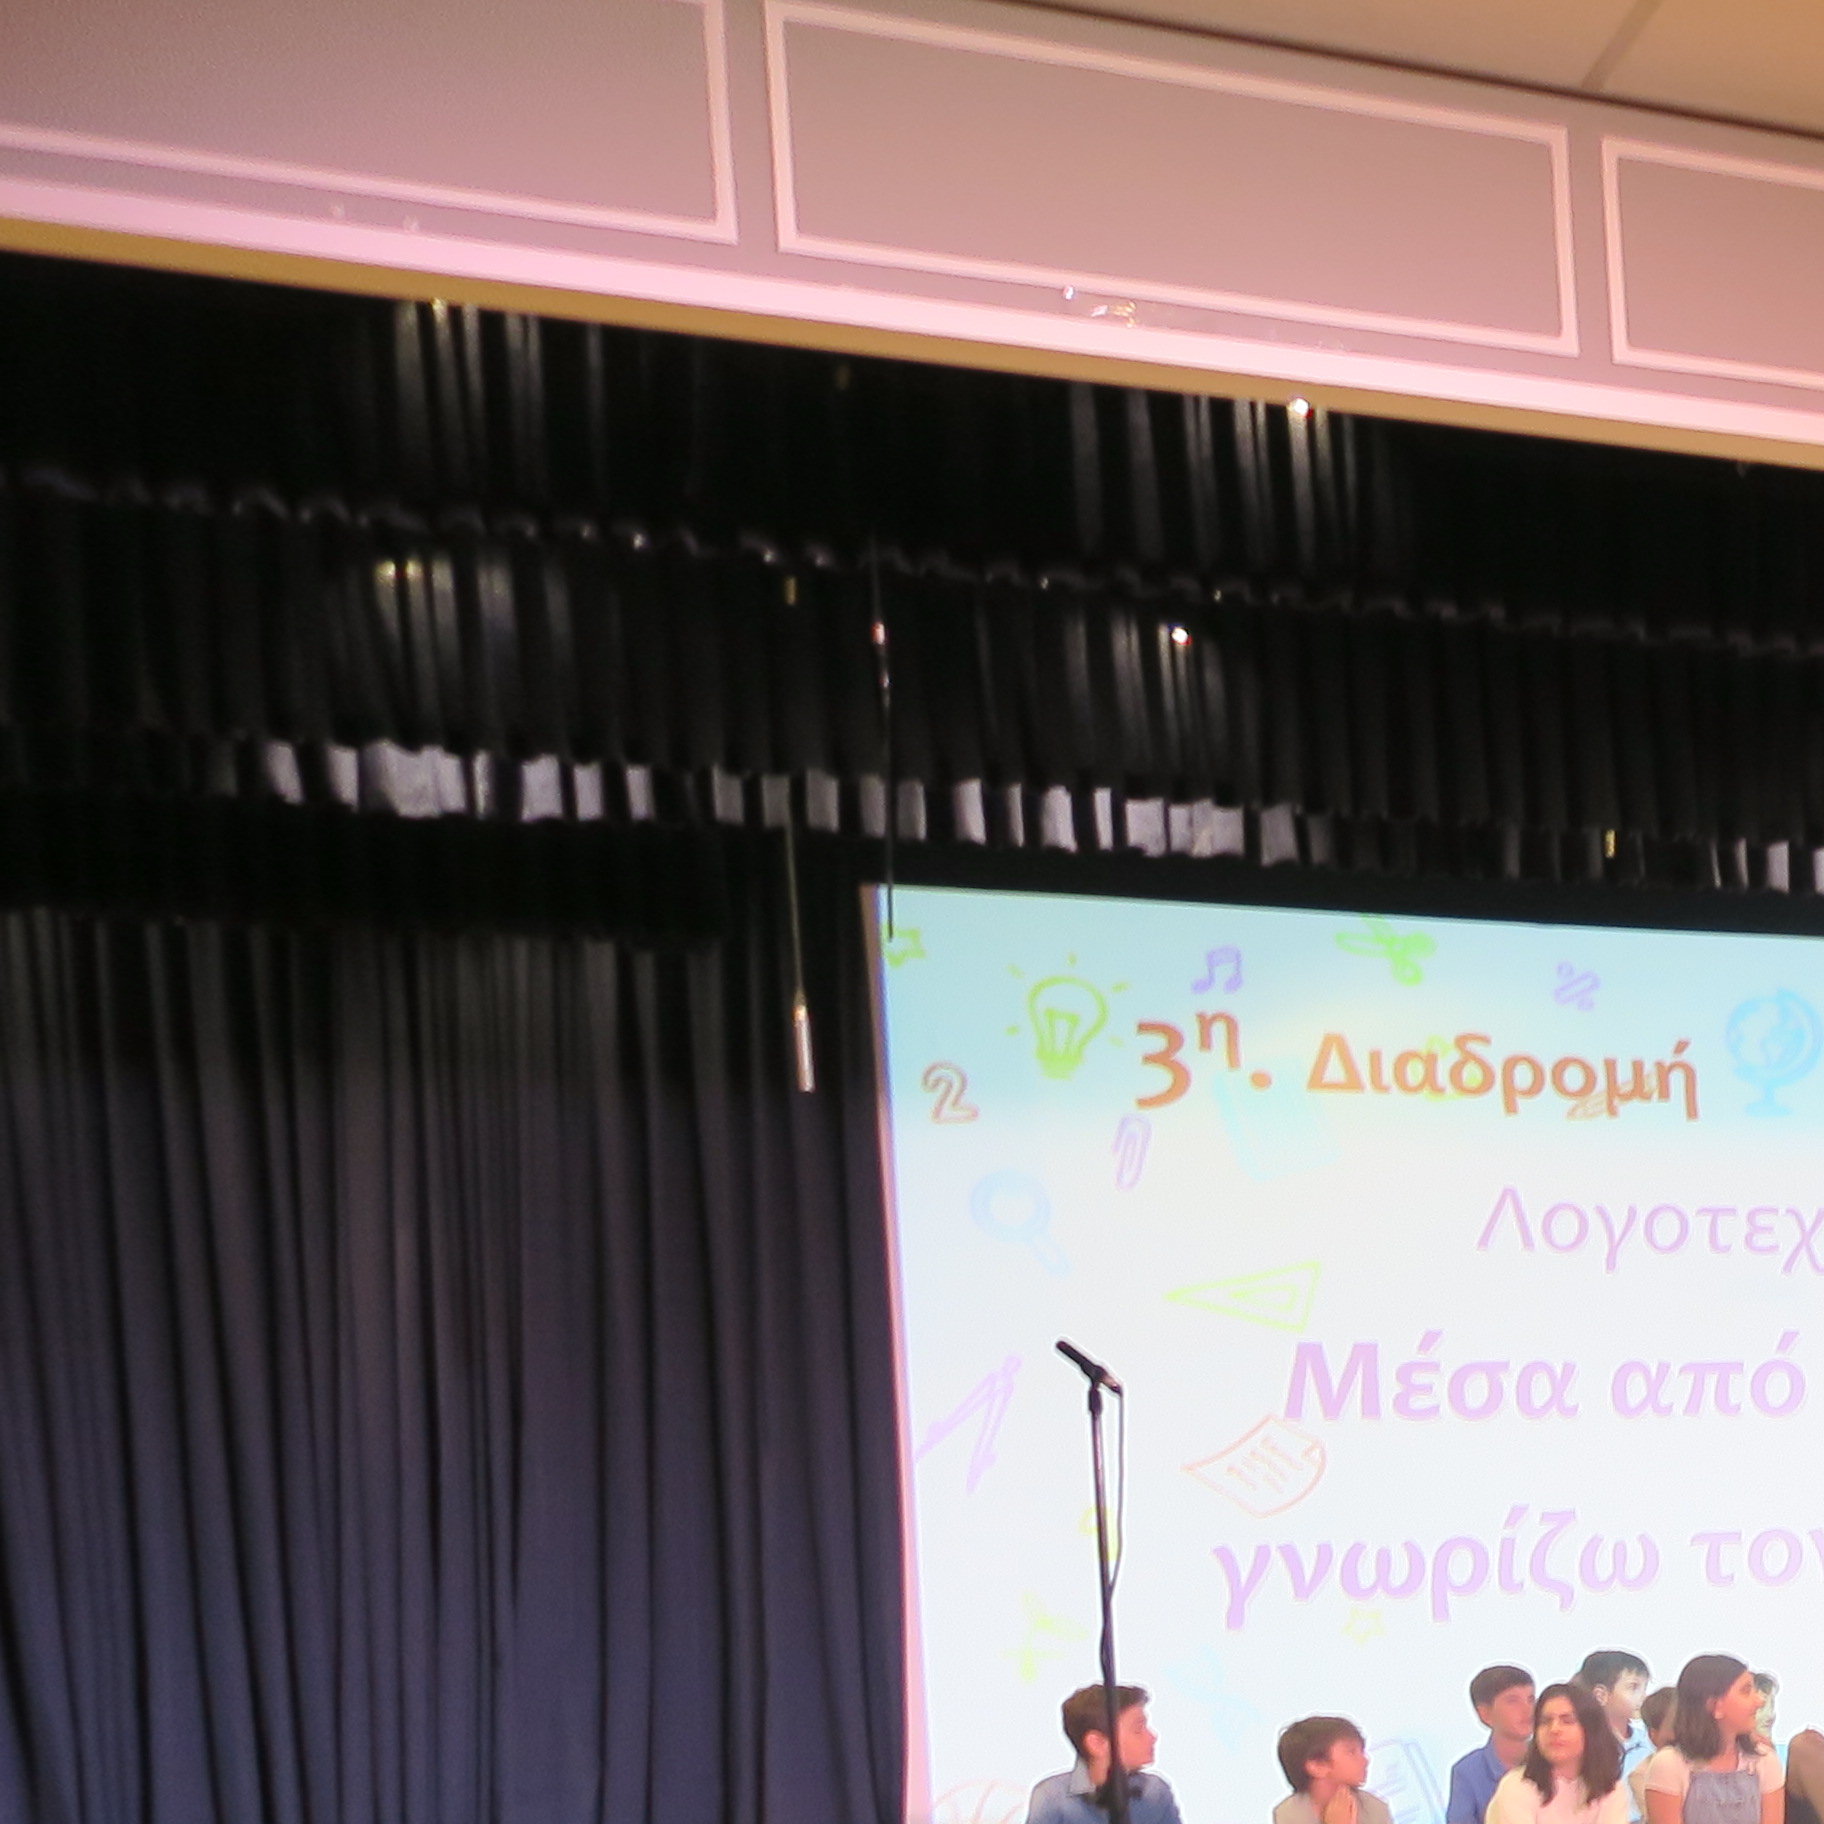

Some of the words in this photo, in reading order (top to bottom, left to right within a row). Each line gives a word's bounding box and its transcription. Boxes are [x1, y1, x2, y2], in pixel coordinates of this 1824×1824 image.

[1307, 1033, 1698, 1118] Διαδρομή
[1283, 1329, 1578, 1420] Μέσα
[1611, 1329, 1805, 1418] από
[1212, 1505, 1660, 1630] γνωρίζω
